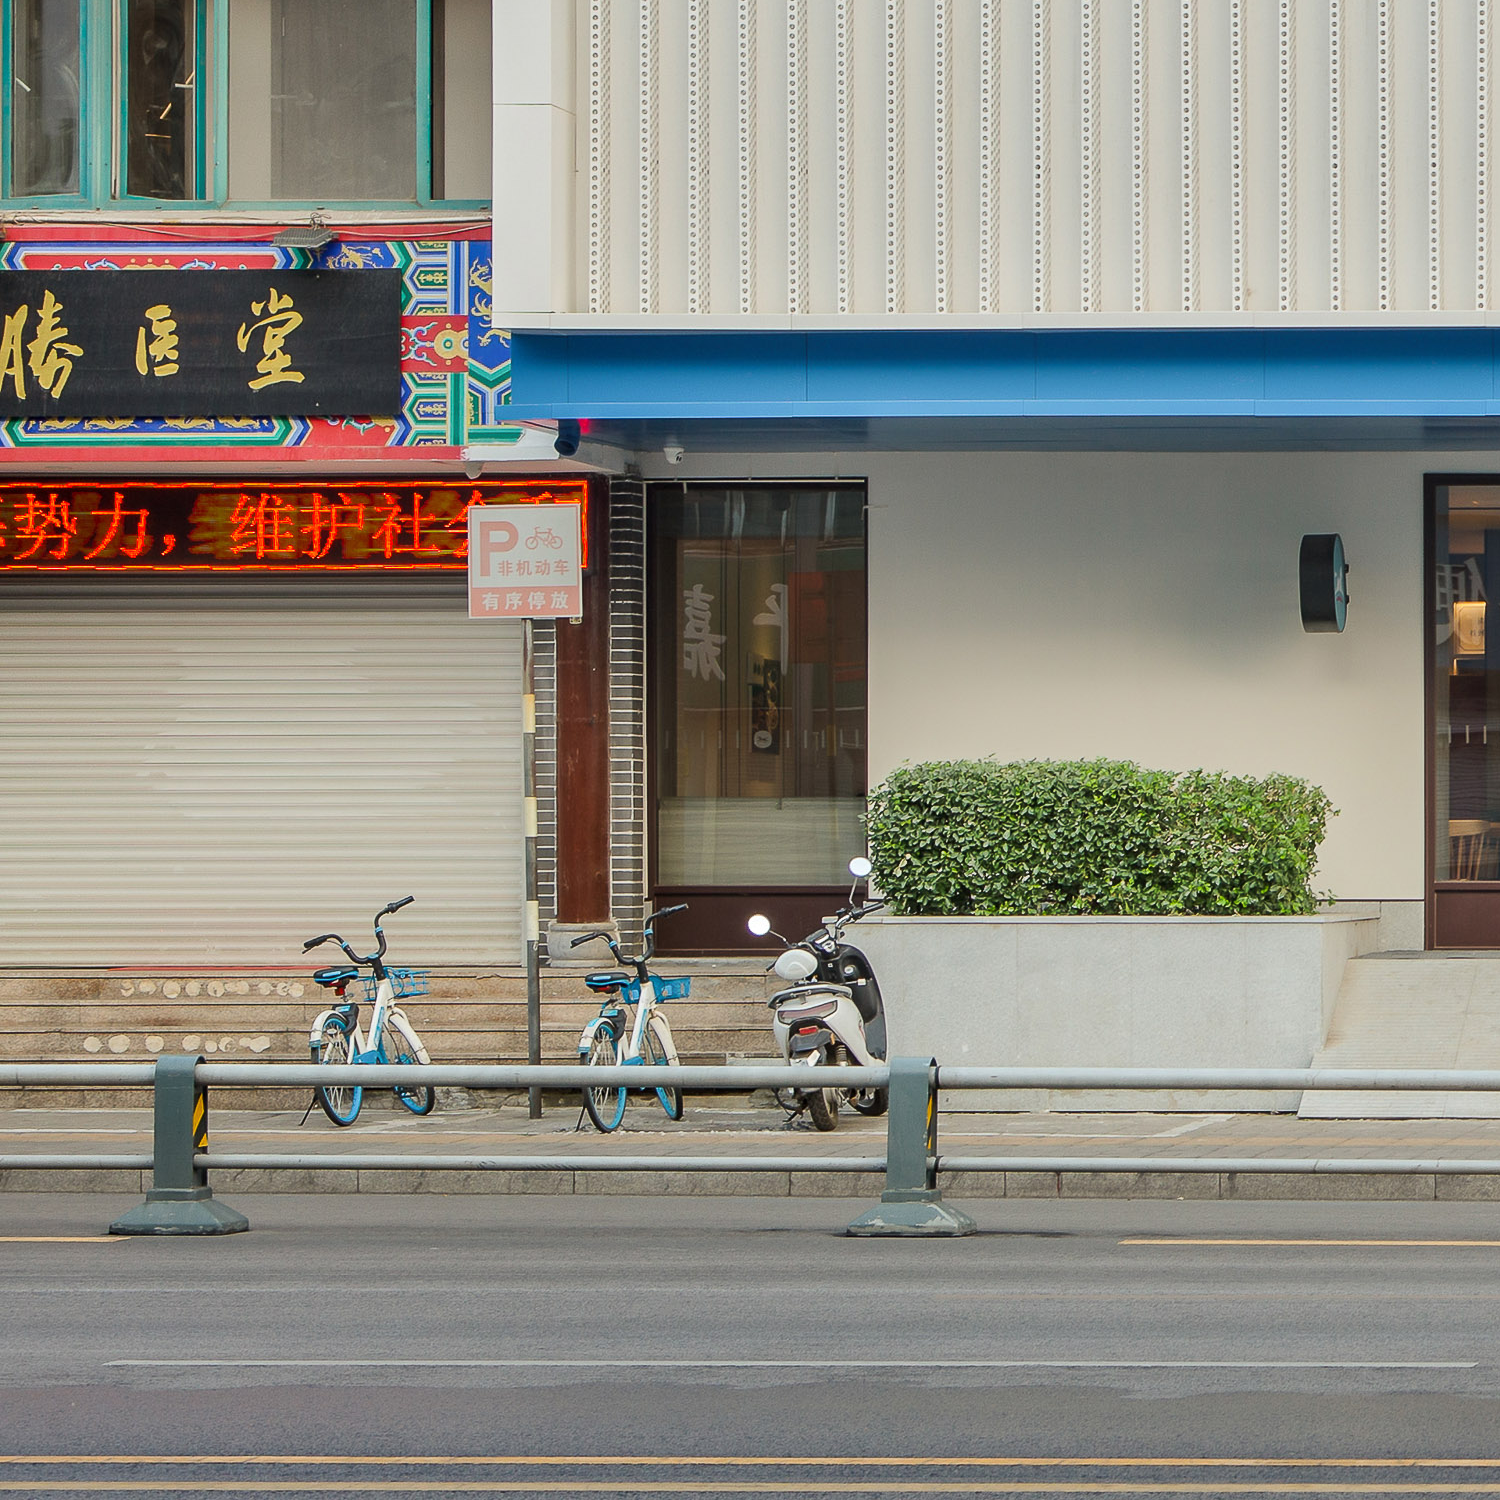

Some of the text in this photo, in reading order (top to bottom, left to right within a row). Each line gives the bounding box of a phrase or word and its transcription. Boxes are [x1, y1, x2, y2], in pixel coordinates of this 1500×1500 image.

[479, 520, 519, 577] P
[497, 560, 571, 577] 非机动车
[481, 591, 569, 612] 有序停放
